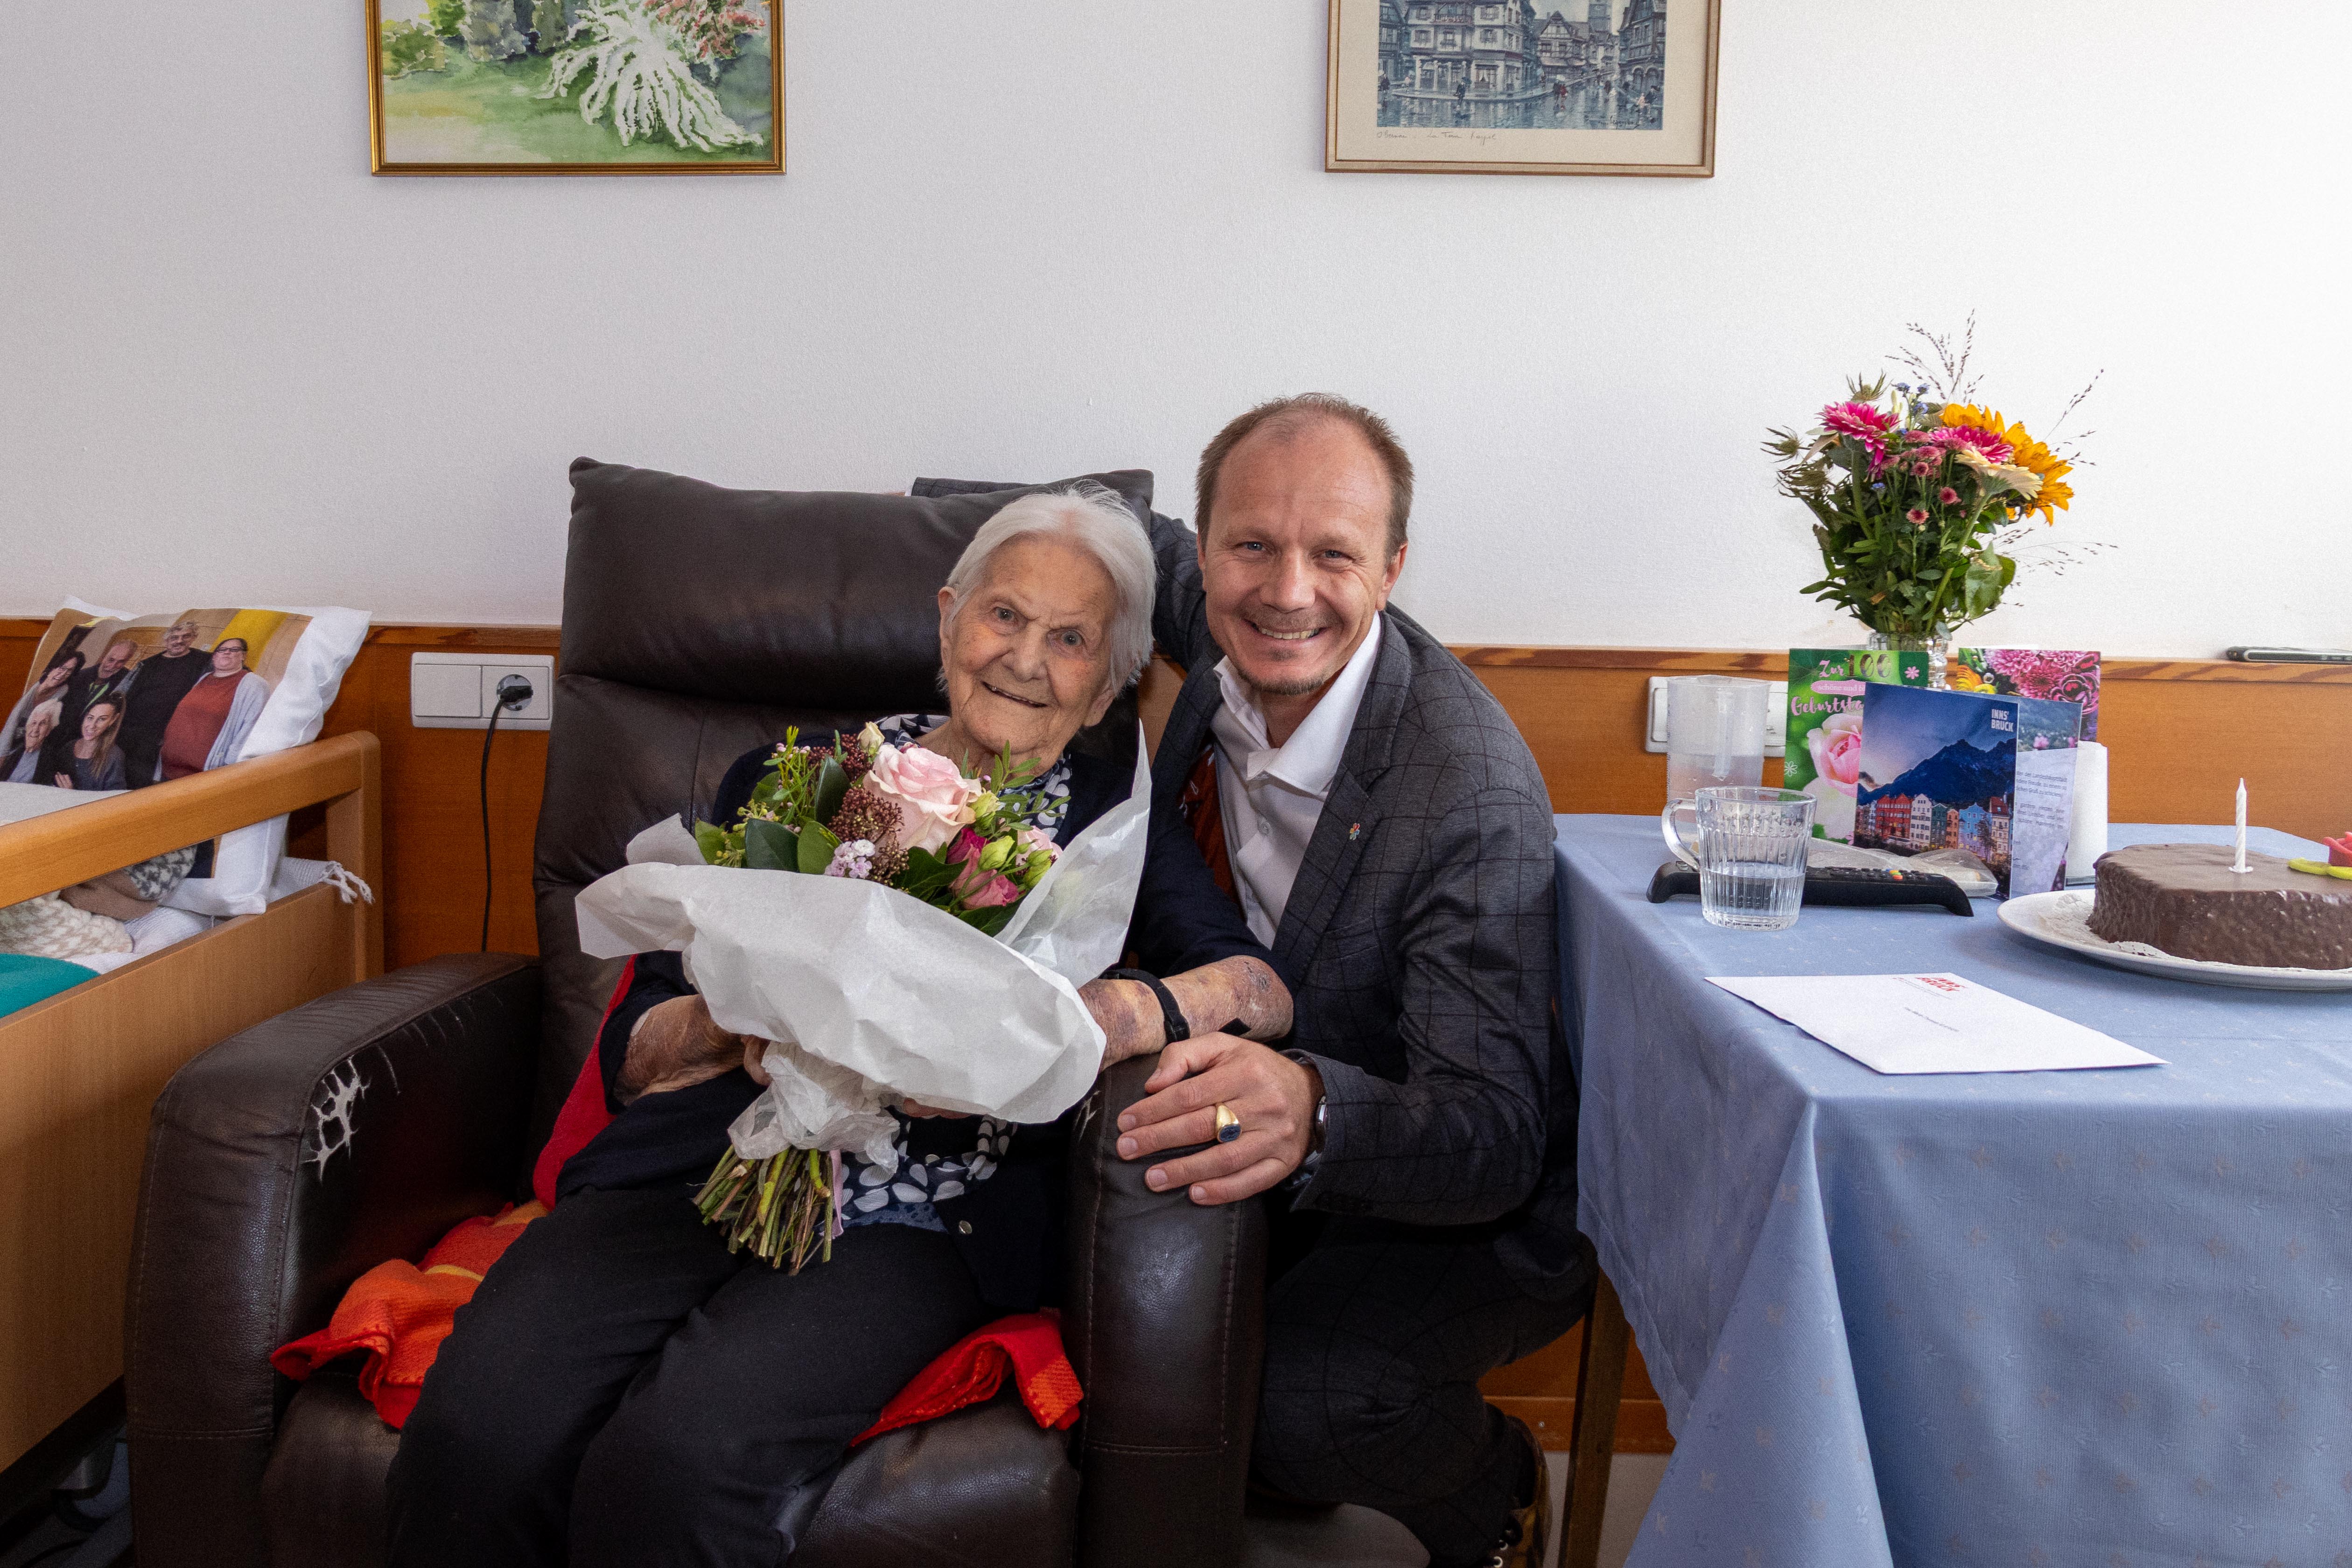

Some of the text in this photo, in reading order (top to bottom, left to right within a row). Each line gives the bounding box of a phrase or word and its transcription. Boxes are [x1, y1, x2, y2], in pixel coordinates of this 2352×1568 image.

[1819, 654, 1891, 678] Zur 100
[1791, 696, 1864, 716] Geburtsta
[1991, 719, 2014, 732] BRUCK
[1915, 977, 1960, 991] BRUCK
